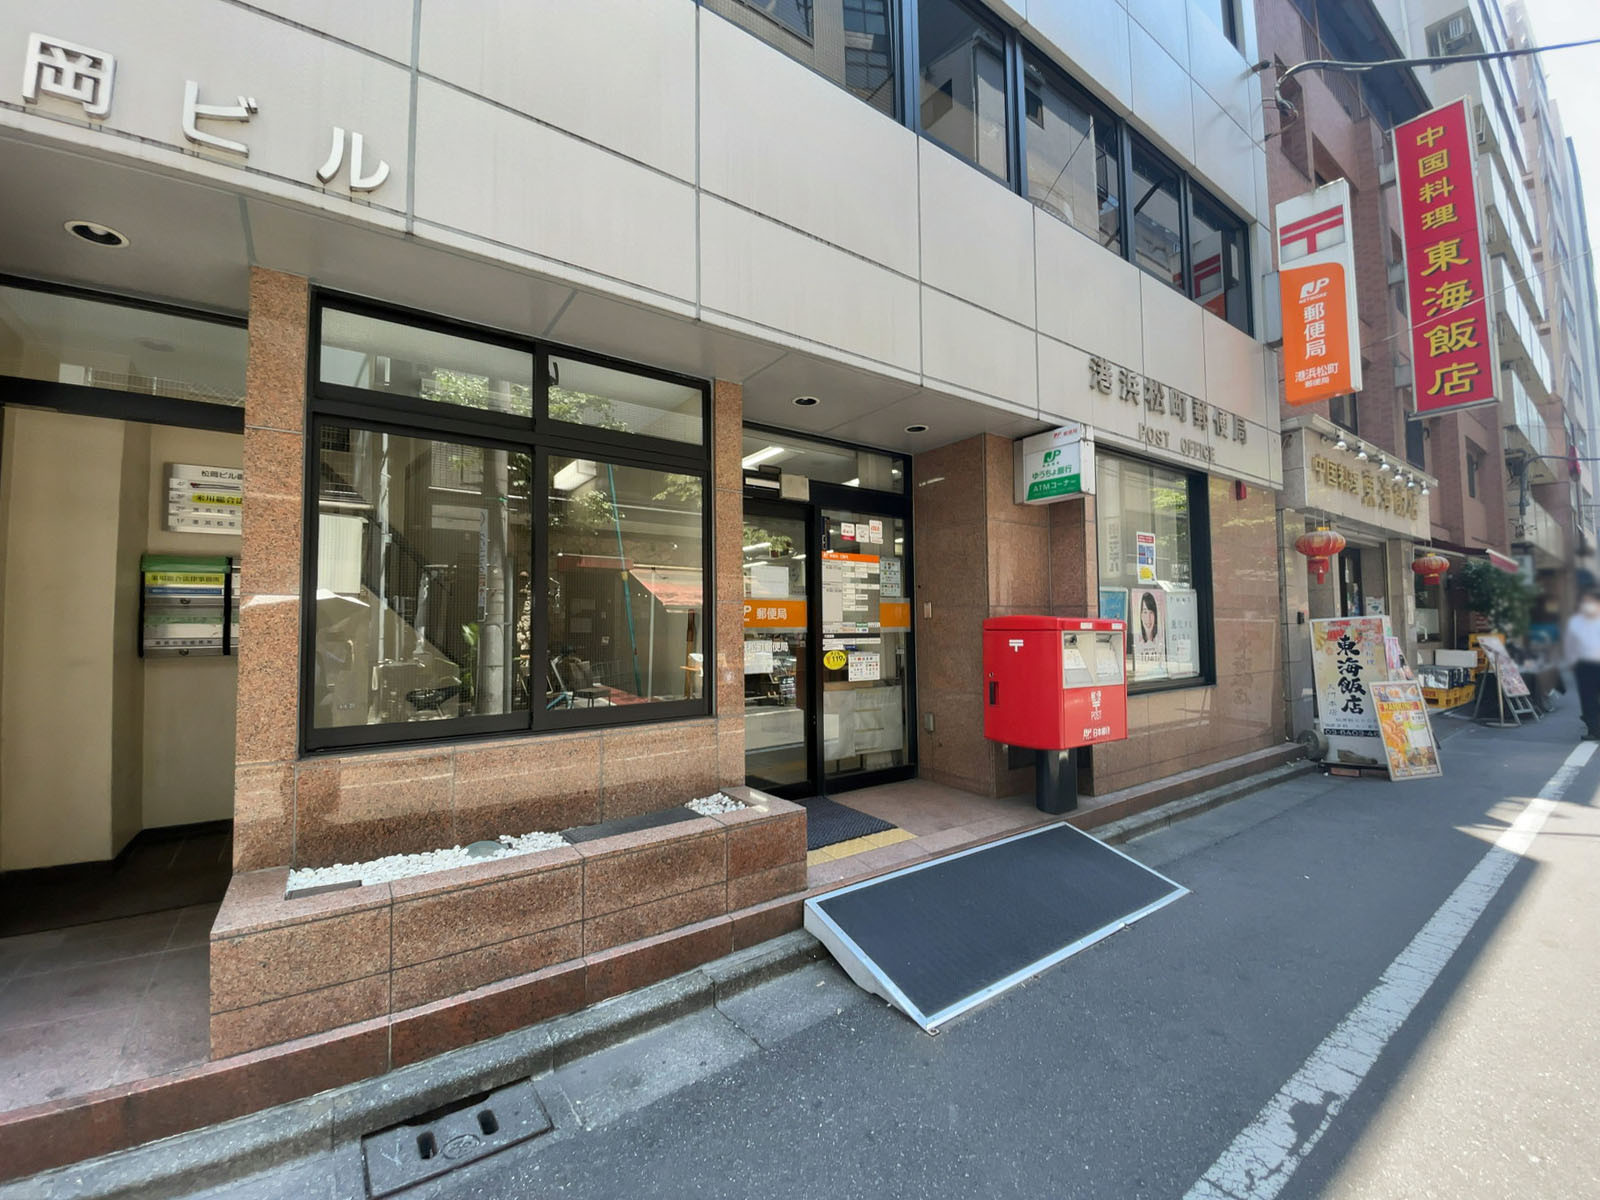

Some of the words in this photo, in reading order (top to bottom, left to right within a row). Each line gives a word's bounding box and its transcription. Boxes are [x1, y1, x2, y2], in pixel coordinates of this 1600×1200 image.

[1416, 125, 1458, 230] 中国料理
[1304, 302, 1326, 360] 郵便局
[1420, 238, 1480, 397] 東海飯店
[1295, 362, 1338, 383] 港浜松町
[1088, 357, 1248, 446] 港浜松町郵便局
[1138, 422, 1170, 449] POST
[1180, 438, 1217, 463] OFFICE
[1032, 464, 1073, 480] ゆうちょ銀行
[1033, 479, 1077, 493] ATMコーナー
[756, 607, 788, 620] 郵便局
[1337, 634, 1366, 715] 東海飯店
